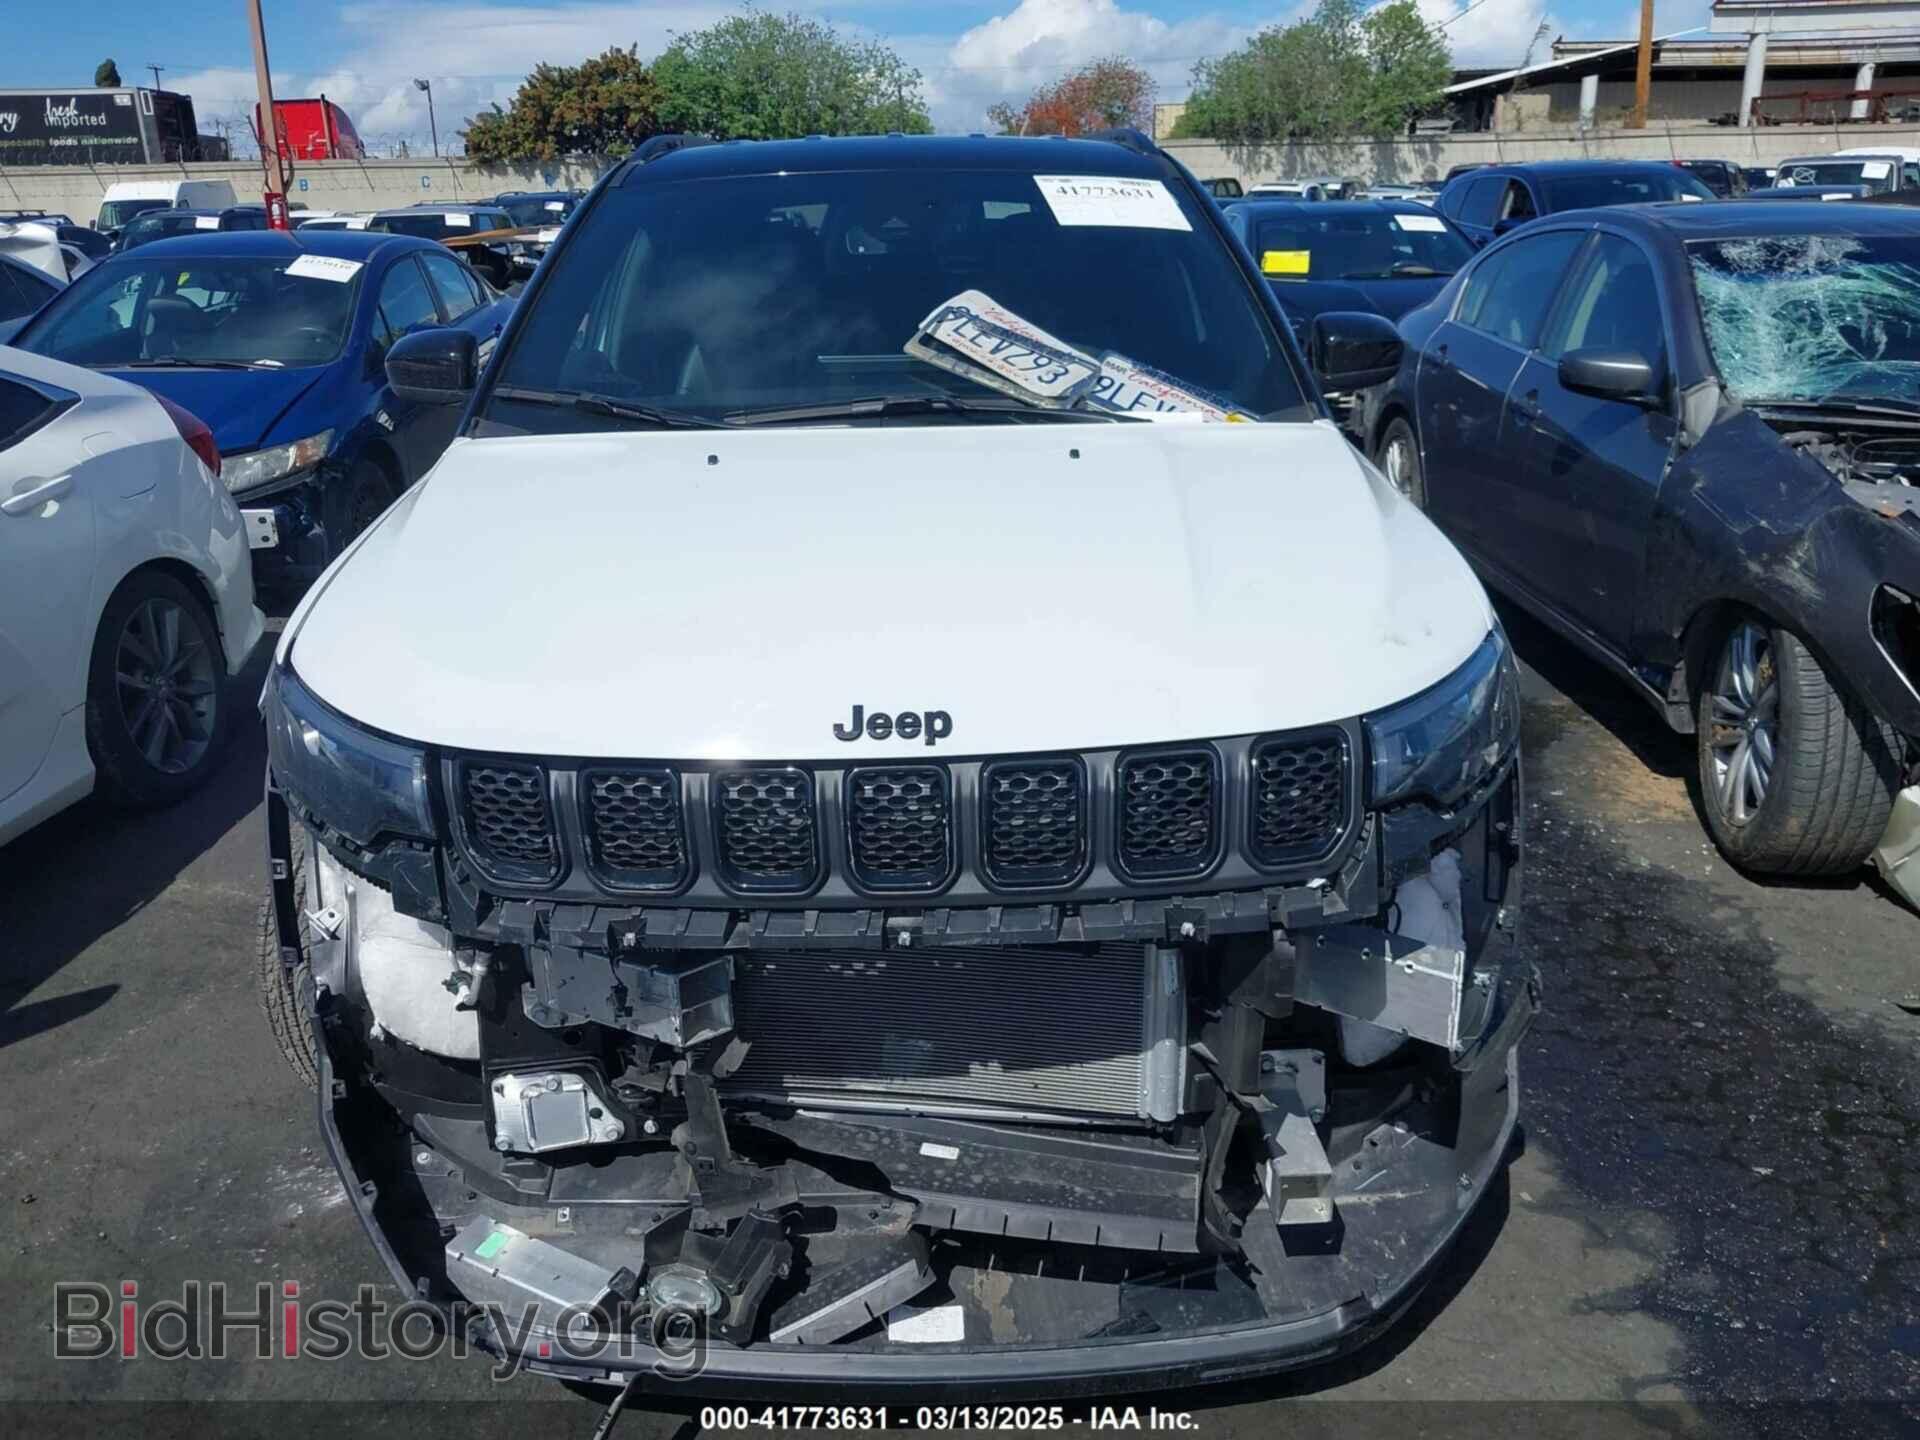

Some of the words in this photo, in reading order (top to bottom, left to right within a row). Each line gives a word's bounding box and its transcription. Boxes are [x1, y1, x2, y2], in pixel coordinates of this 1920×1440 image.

[44, 112, 107, 128] imported
[81, 136, 139, 145] nationwide
[299, 179, 309, 192] B
[1055, 185, 1156, 200] 41773631
[936, 304, 1069, 385] 9LEV293
[1127, 371, 1217, 418] California
[833, 704, 953, 746] Jeep
